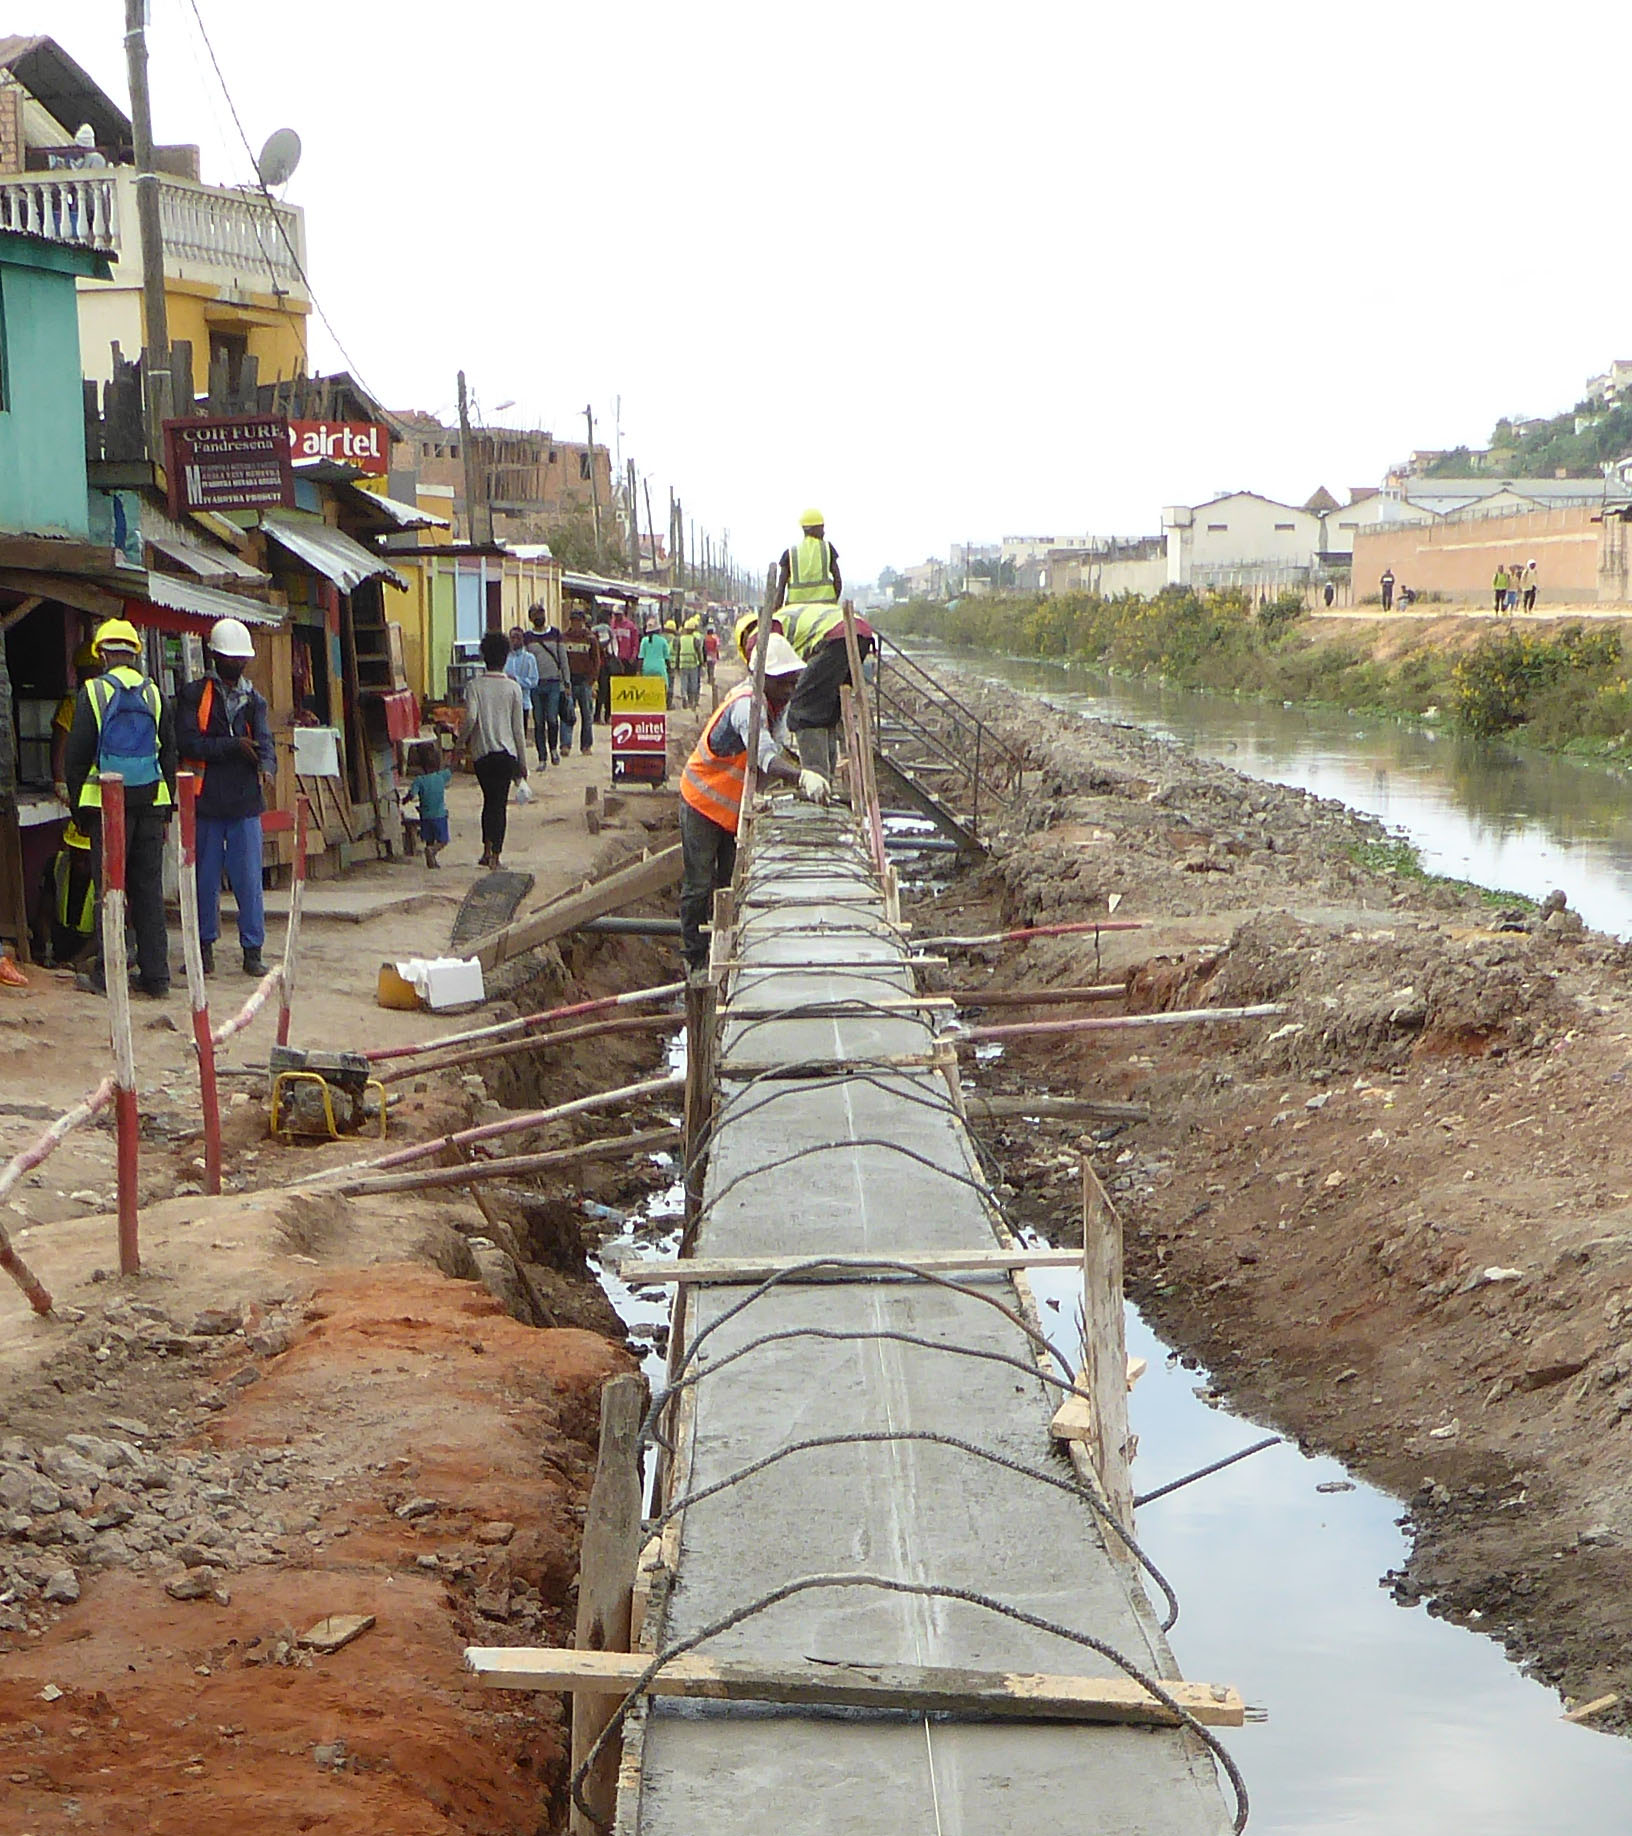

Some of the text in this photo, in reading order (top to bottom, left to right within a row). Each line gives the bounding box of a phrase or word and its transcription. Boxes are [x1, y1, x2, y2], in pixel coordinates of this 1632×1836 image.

[182, 424, 282, 441] COIFFURE
[303, 425, 381, 457] airtel
[635, 721, 664, 734] airtel
